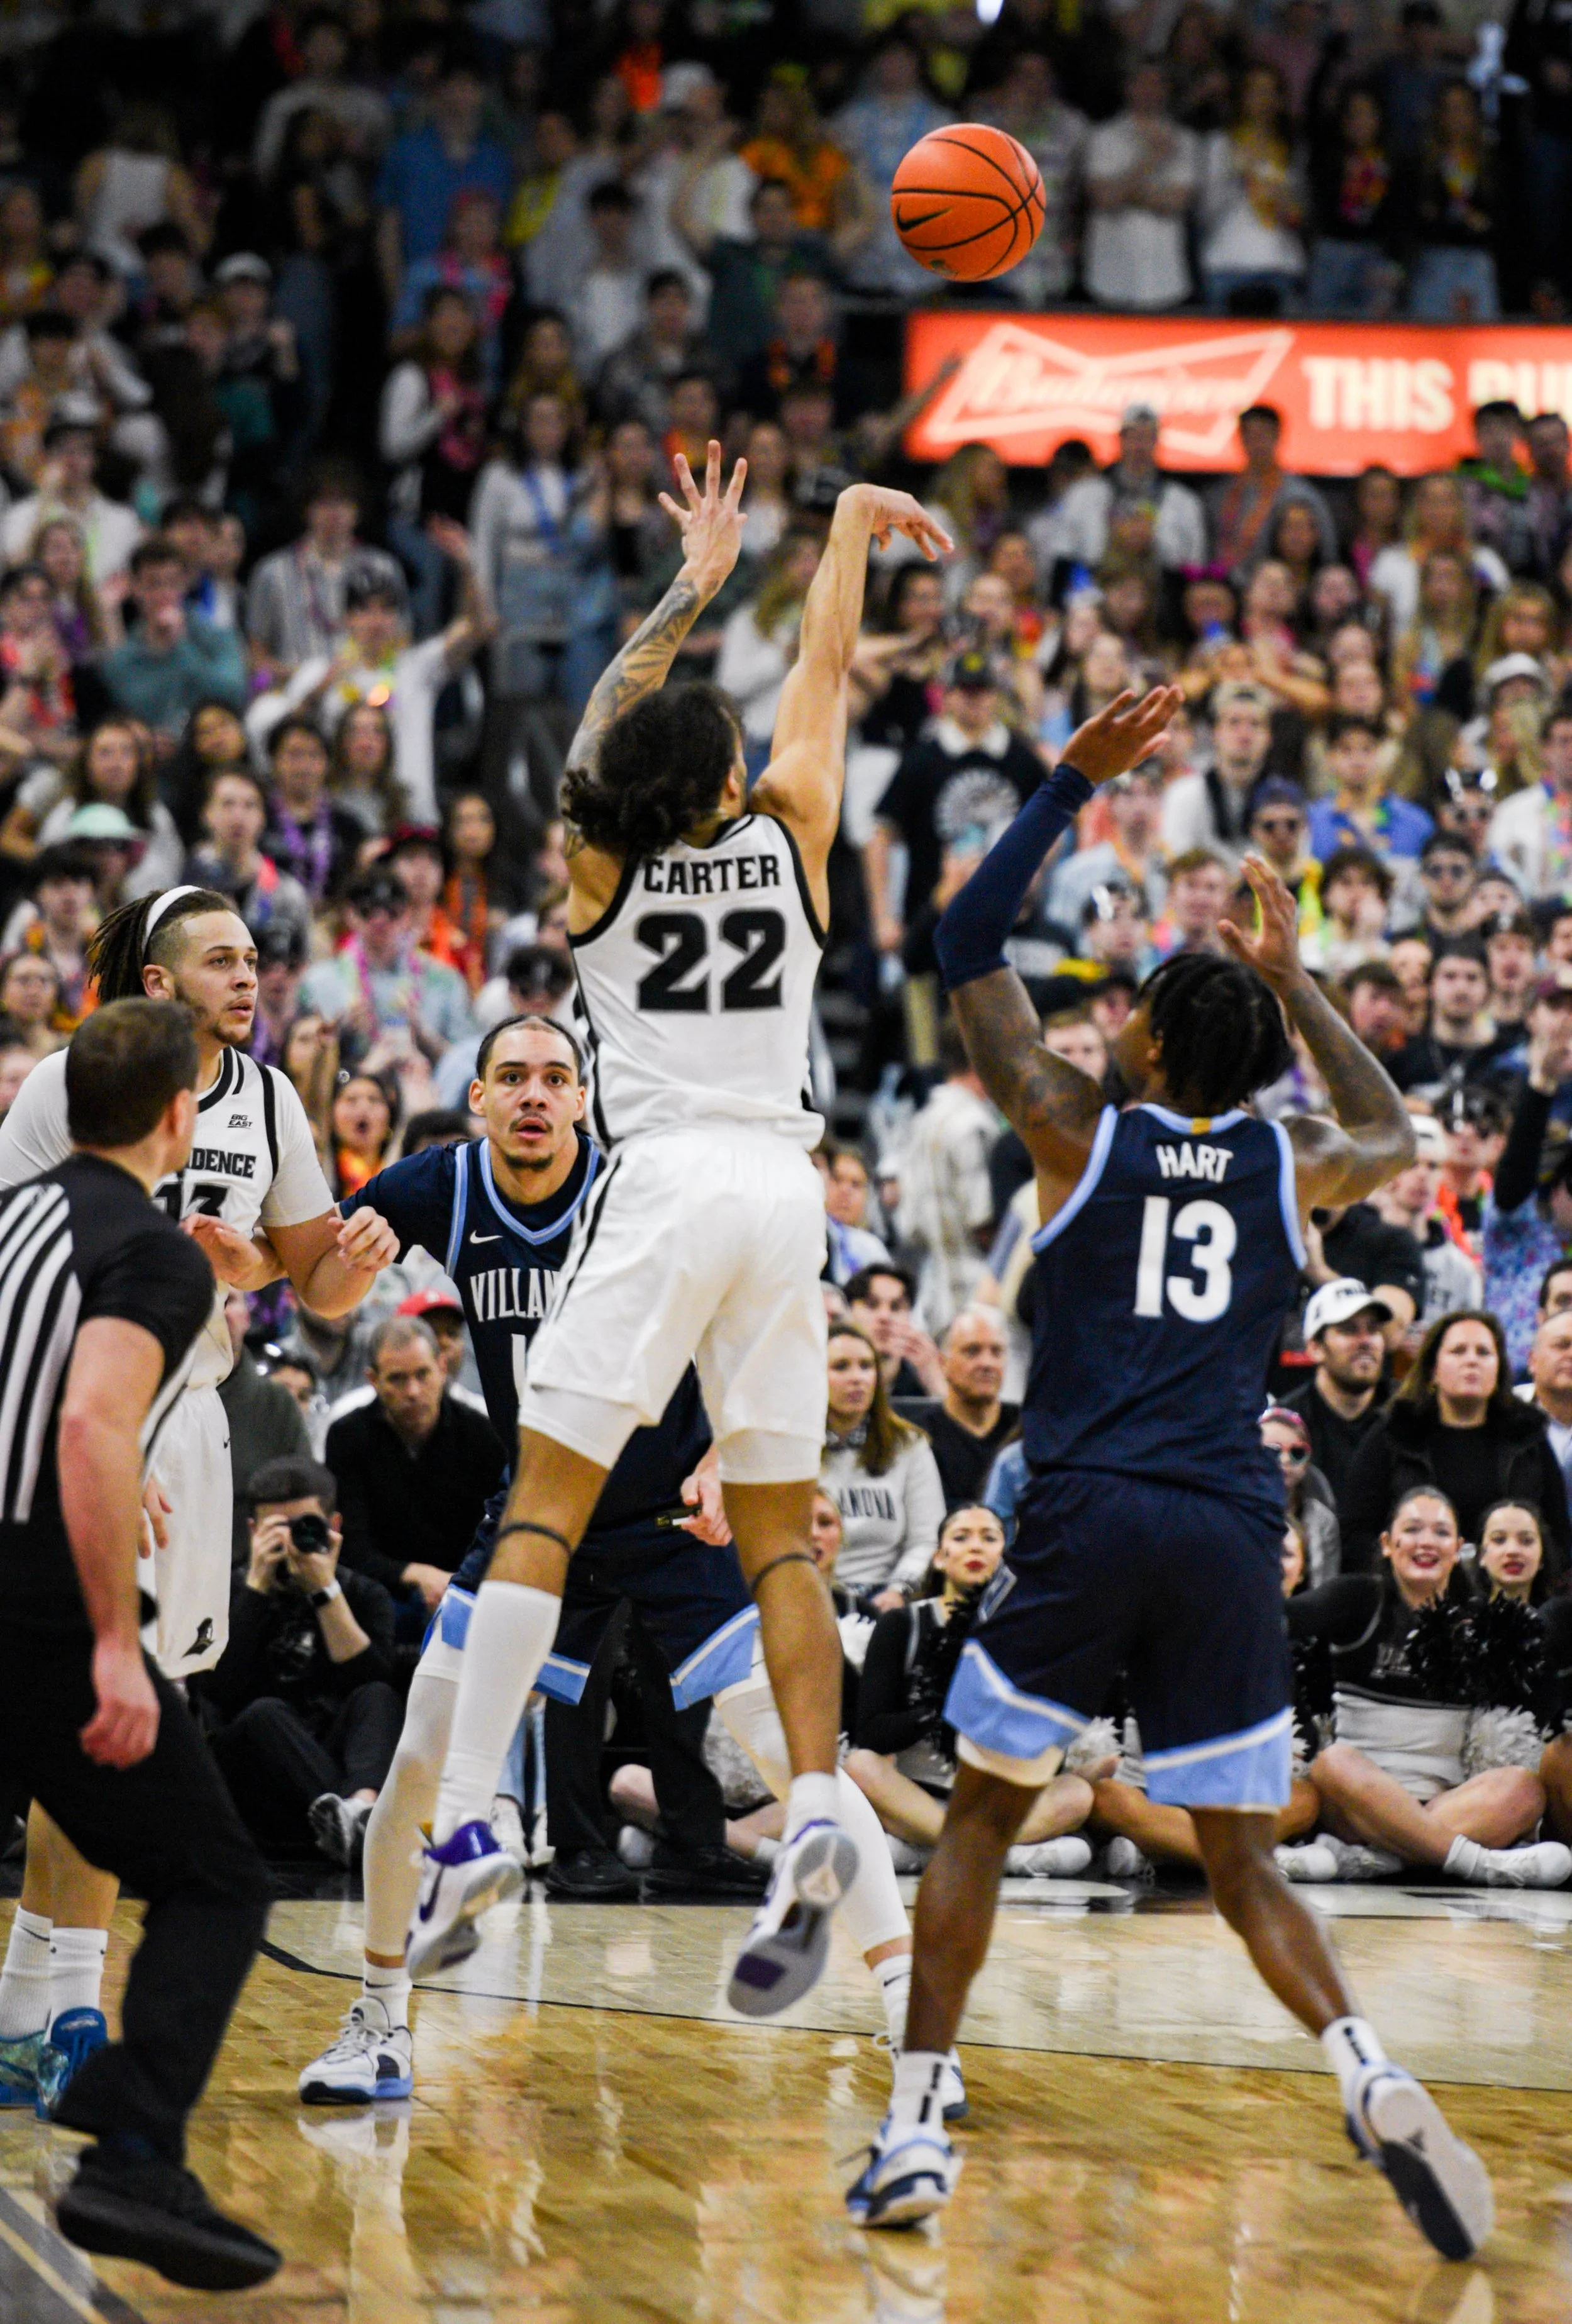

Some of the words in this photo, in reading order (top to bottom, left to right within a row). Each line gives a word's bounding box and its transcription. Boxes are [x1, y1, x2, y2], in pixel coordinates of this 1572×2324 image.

[1302, 356, 1454, 433] THIS
[644, 854, 781, 894] CARTER
[634, 908, 787, 1013] 22
[1155, 1141, 1233, 1183] HART
[1134, 1194, 1237, 1324] 13
